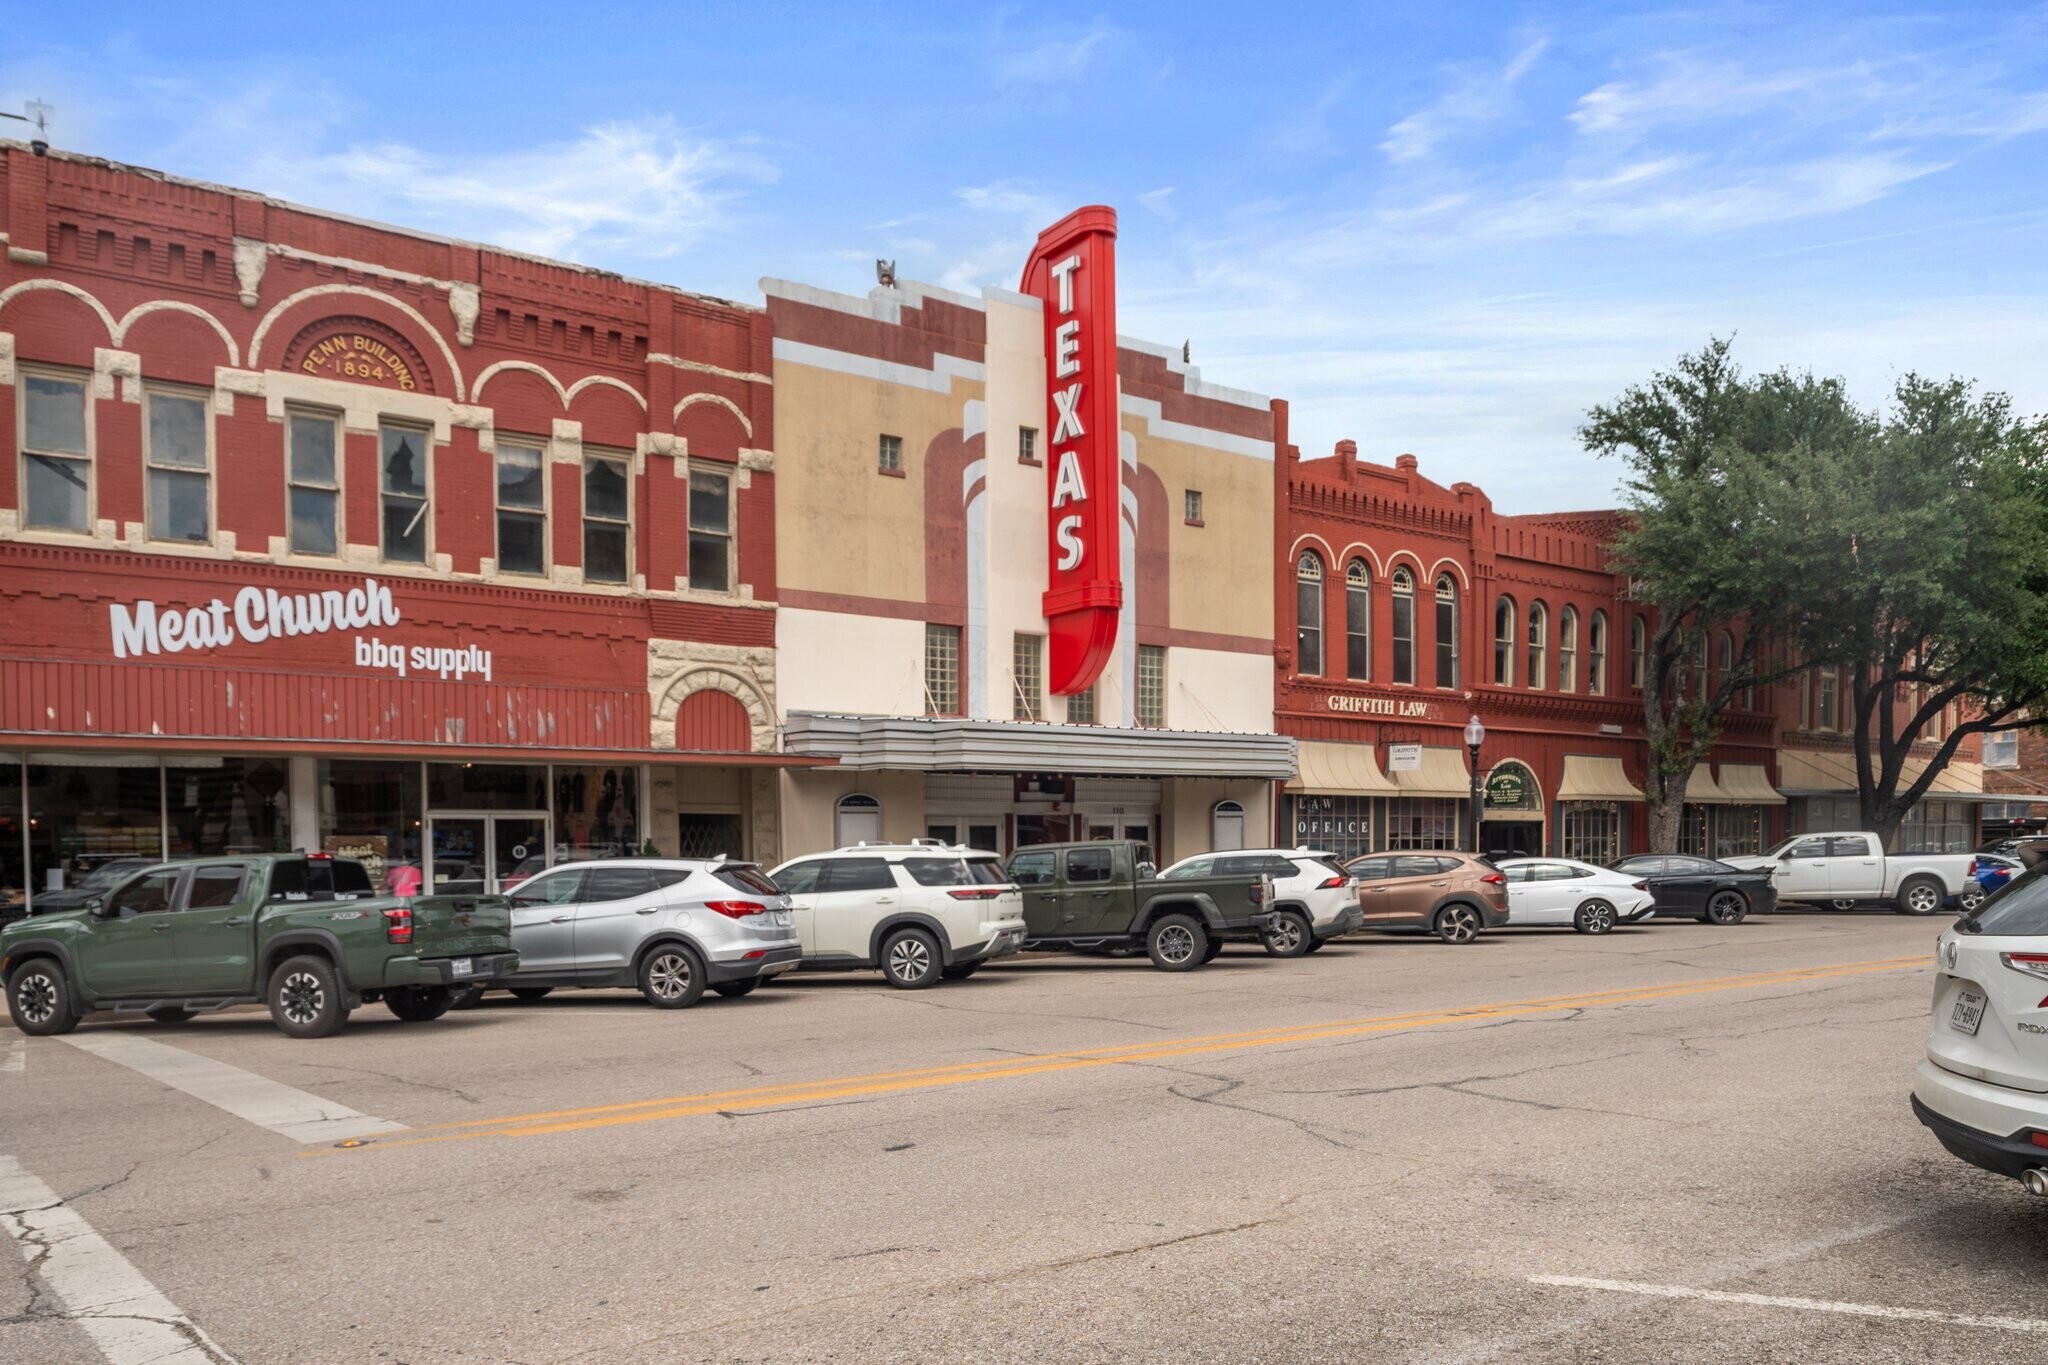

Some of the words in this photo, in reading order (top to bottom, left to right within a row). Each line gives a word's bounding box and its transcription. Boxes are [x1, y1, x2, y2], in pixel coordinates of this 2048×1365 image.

[302, 335, 348, 374] PENN
[353, 335, 416, 391] BUILDING
[335, 359, 385, 380] 1894
[1052, 254, 1089, 572] TEXAS
[109, 599, 234, 659] Meat
[234, 578, 400, 644] Church
[355, 636, 406, 677] bbq
[410, 643, 492, 682] supply
[1327, 695, 1395, 715] GRIFFITH
[1398, 700, 1428, 717] LAW
[1113, 807, 1125, 815] 110
[1299, 797, 1333, 810] LAW
[1298, 821, 1368, 833] OFFICE
